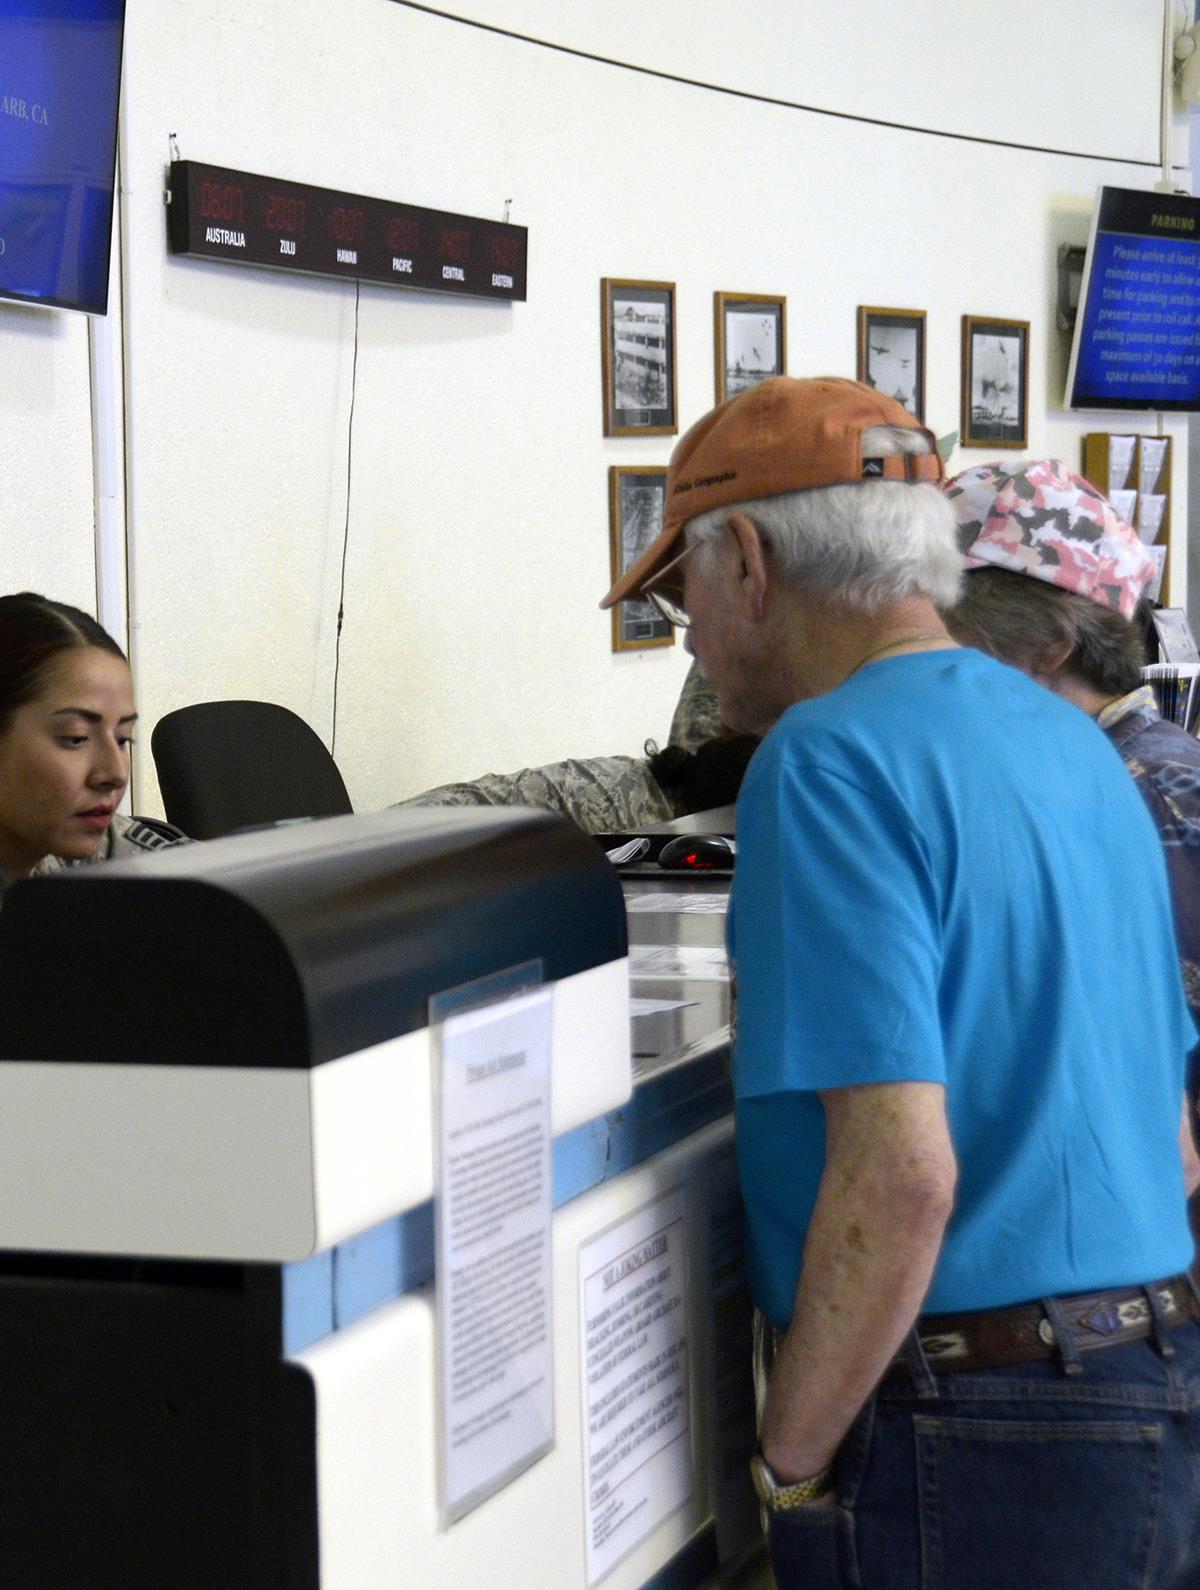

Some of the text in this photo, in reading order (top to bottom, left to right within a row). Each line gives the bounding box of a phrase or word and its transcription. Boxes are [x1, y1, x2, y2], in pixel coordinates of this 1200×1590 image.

[32, 104, 49, 126] CA
[1151, 214, 1195, 231] PARKING
[205, 227, 246, 248] AUSTRALIA
[279, 239, 296, 255] ZULU
[336, 249, 357, 265] HAWAII
[392, 257, 413, 274] PACIFIC
[442, 265, 465, 281] CENTRAL
[1105, 266, 1139, 281] minutes
[491, 273, 513, 288] EASTERN
